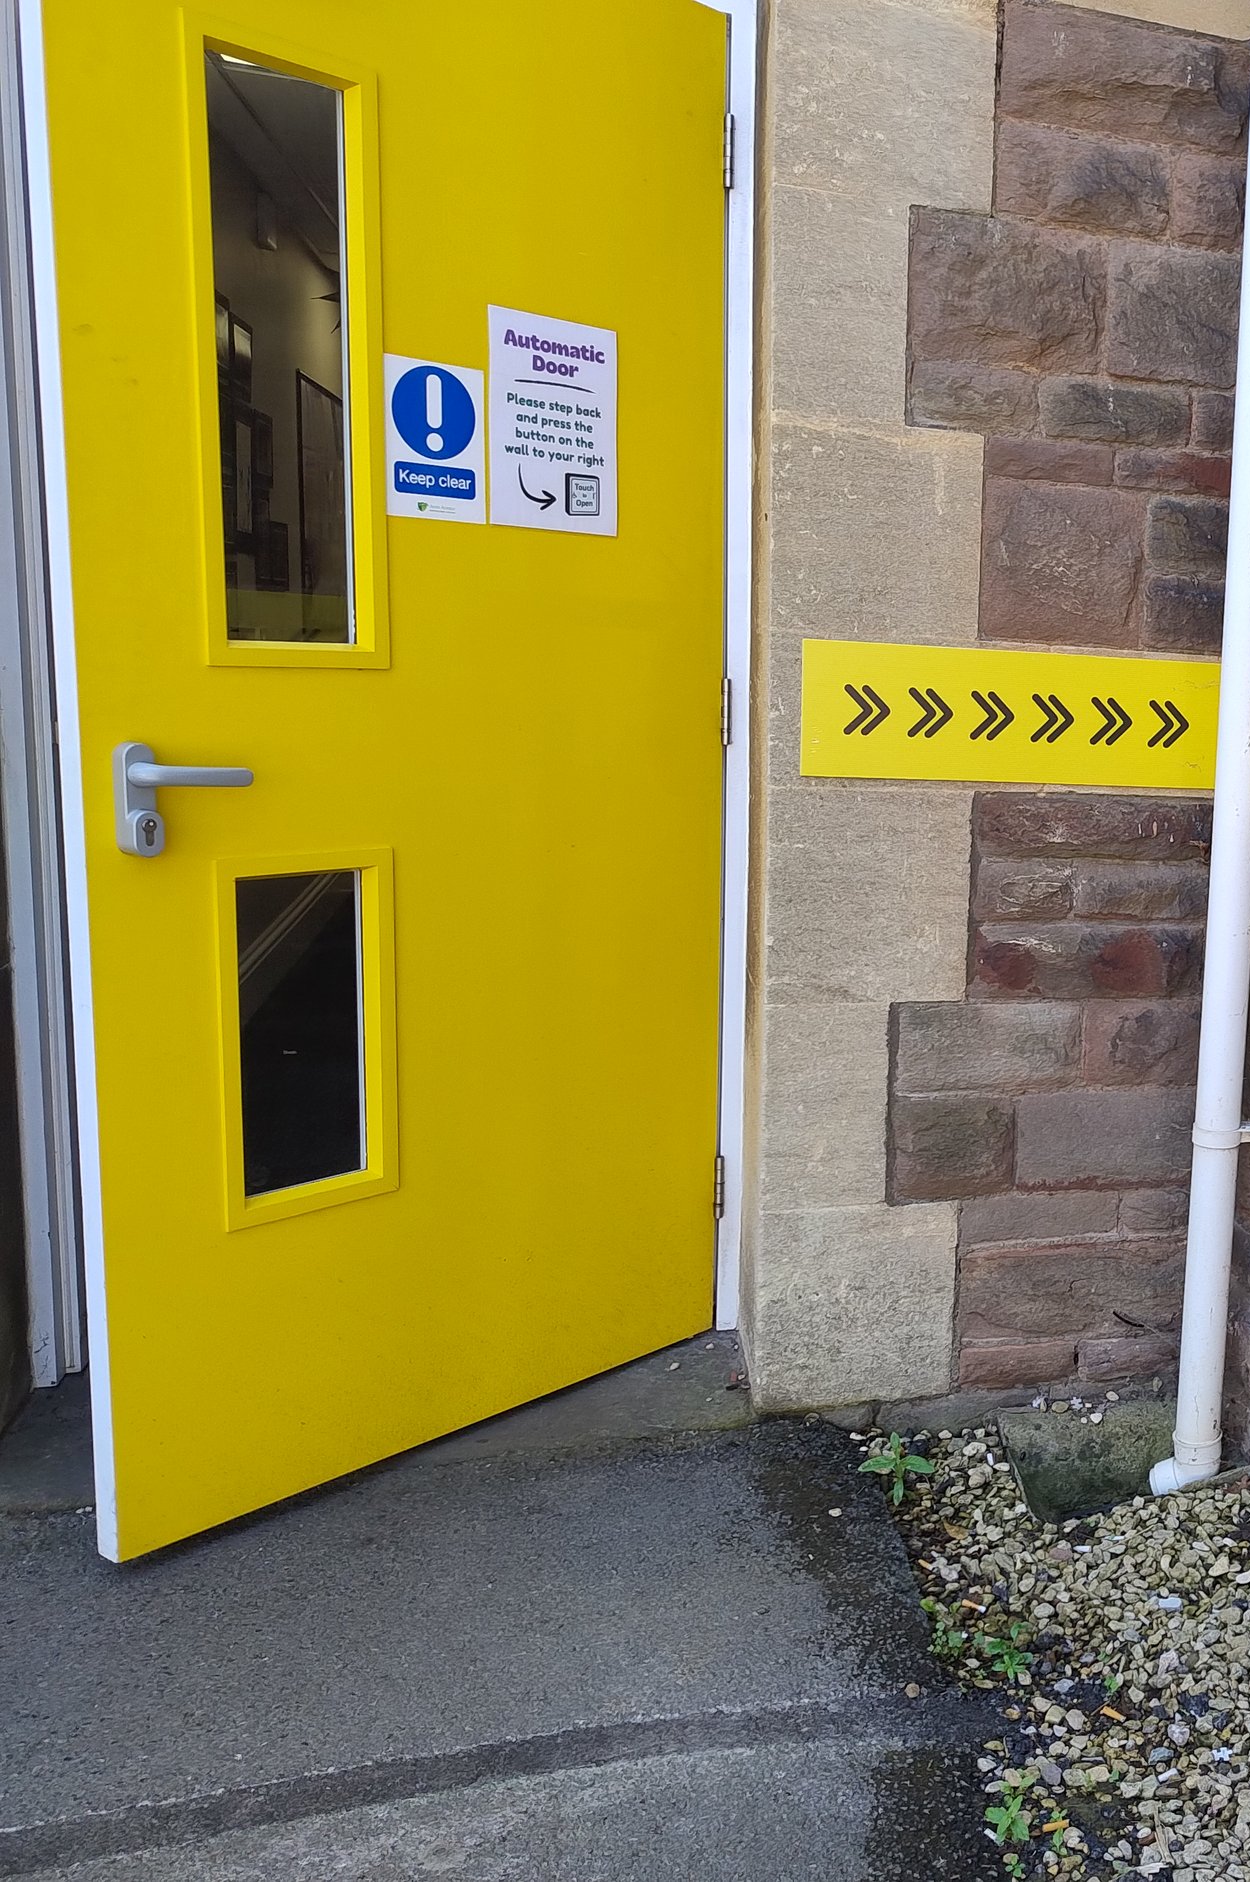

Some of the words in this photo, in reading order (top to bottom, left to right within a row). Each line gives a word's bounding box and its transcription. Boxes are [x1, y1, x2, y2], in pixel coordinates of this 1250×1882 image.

[504, 329, 605, 364] Automatic
[532, 354, 579, 378] Door
[507, 392, 546, 409] Please
[549, 401, 573, 416] step
[576, 404, 602, 419] back
[516, 413, 538, 424] and
[541, 416, 572, 430] press
[574, 420, 593, 433] the
[515, 427, 555, 443] button
[558, 436, 573, 446] on
[575, 436, 595, 449] the
[504, 444, 529, 456] wall
[532, 446, 545, 458] to
[548, 451, 575, 462] your
[577, 452, 605, 468] right
[398, 468, 435, 488] Keep
[438, 474, 471, 490] clear
[574, 482, 595, 492] Touch
[575, 499, 593, 508] Open
